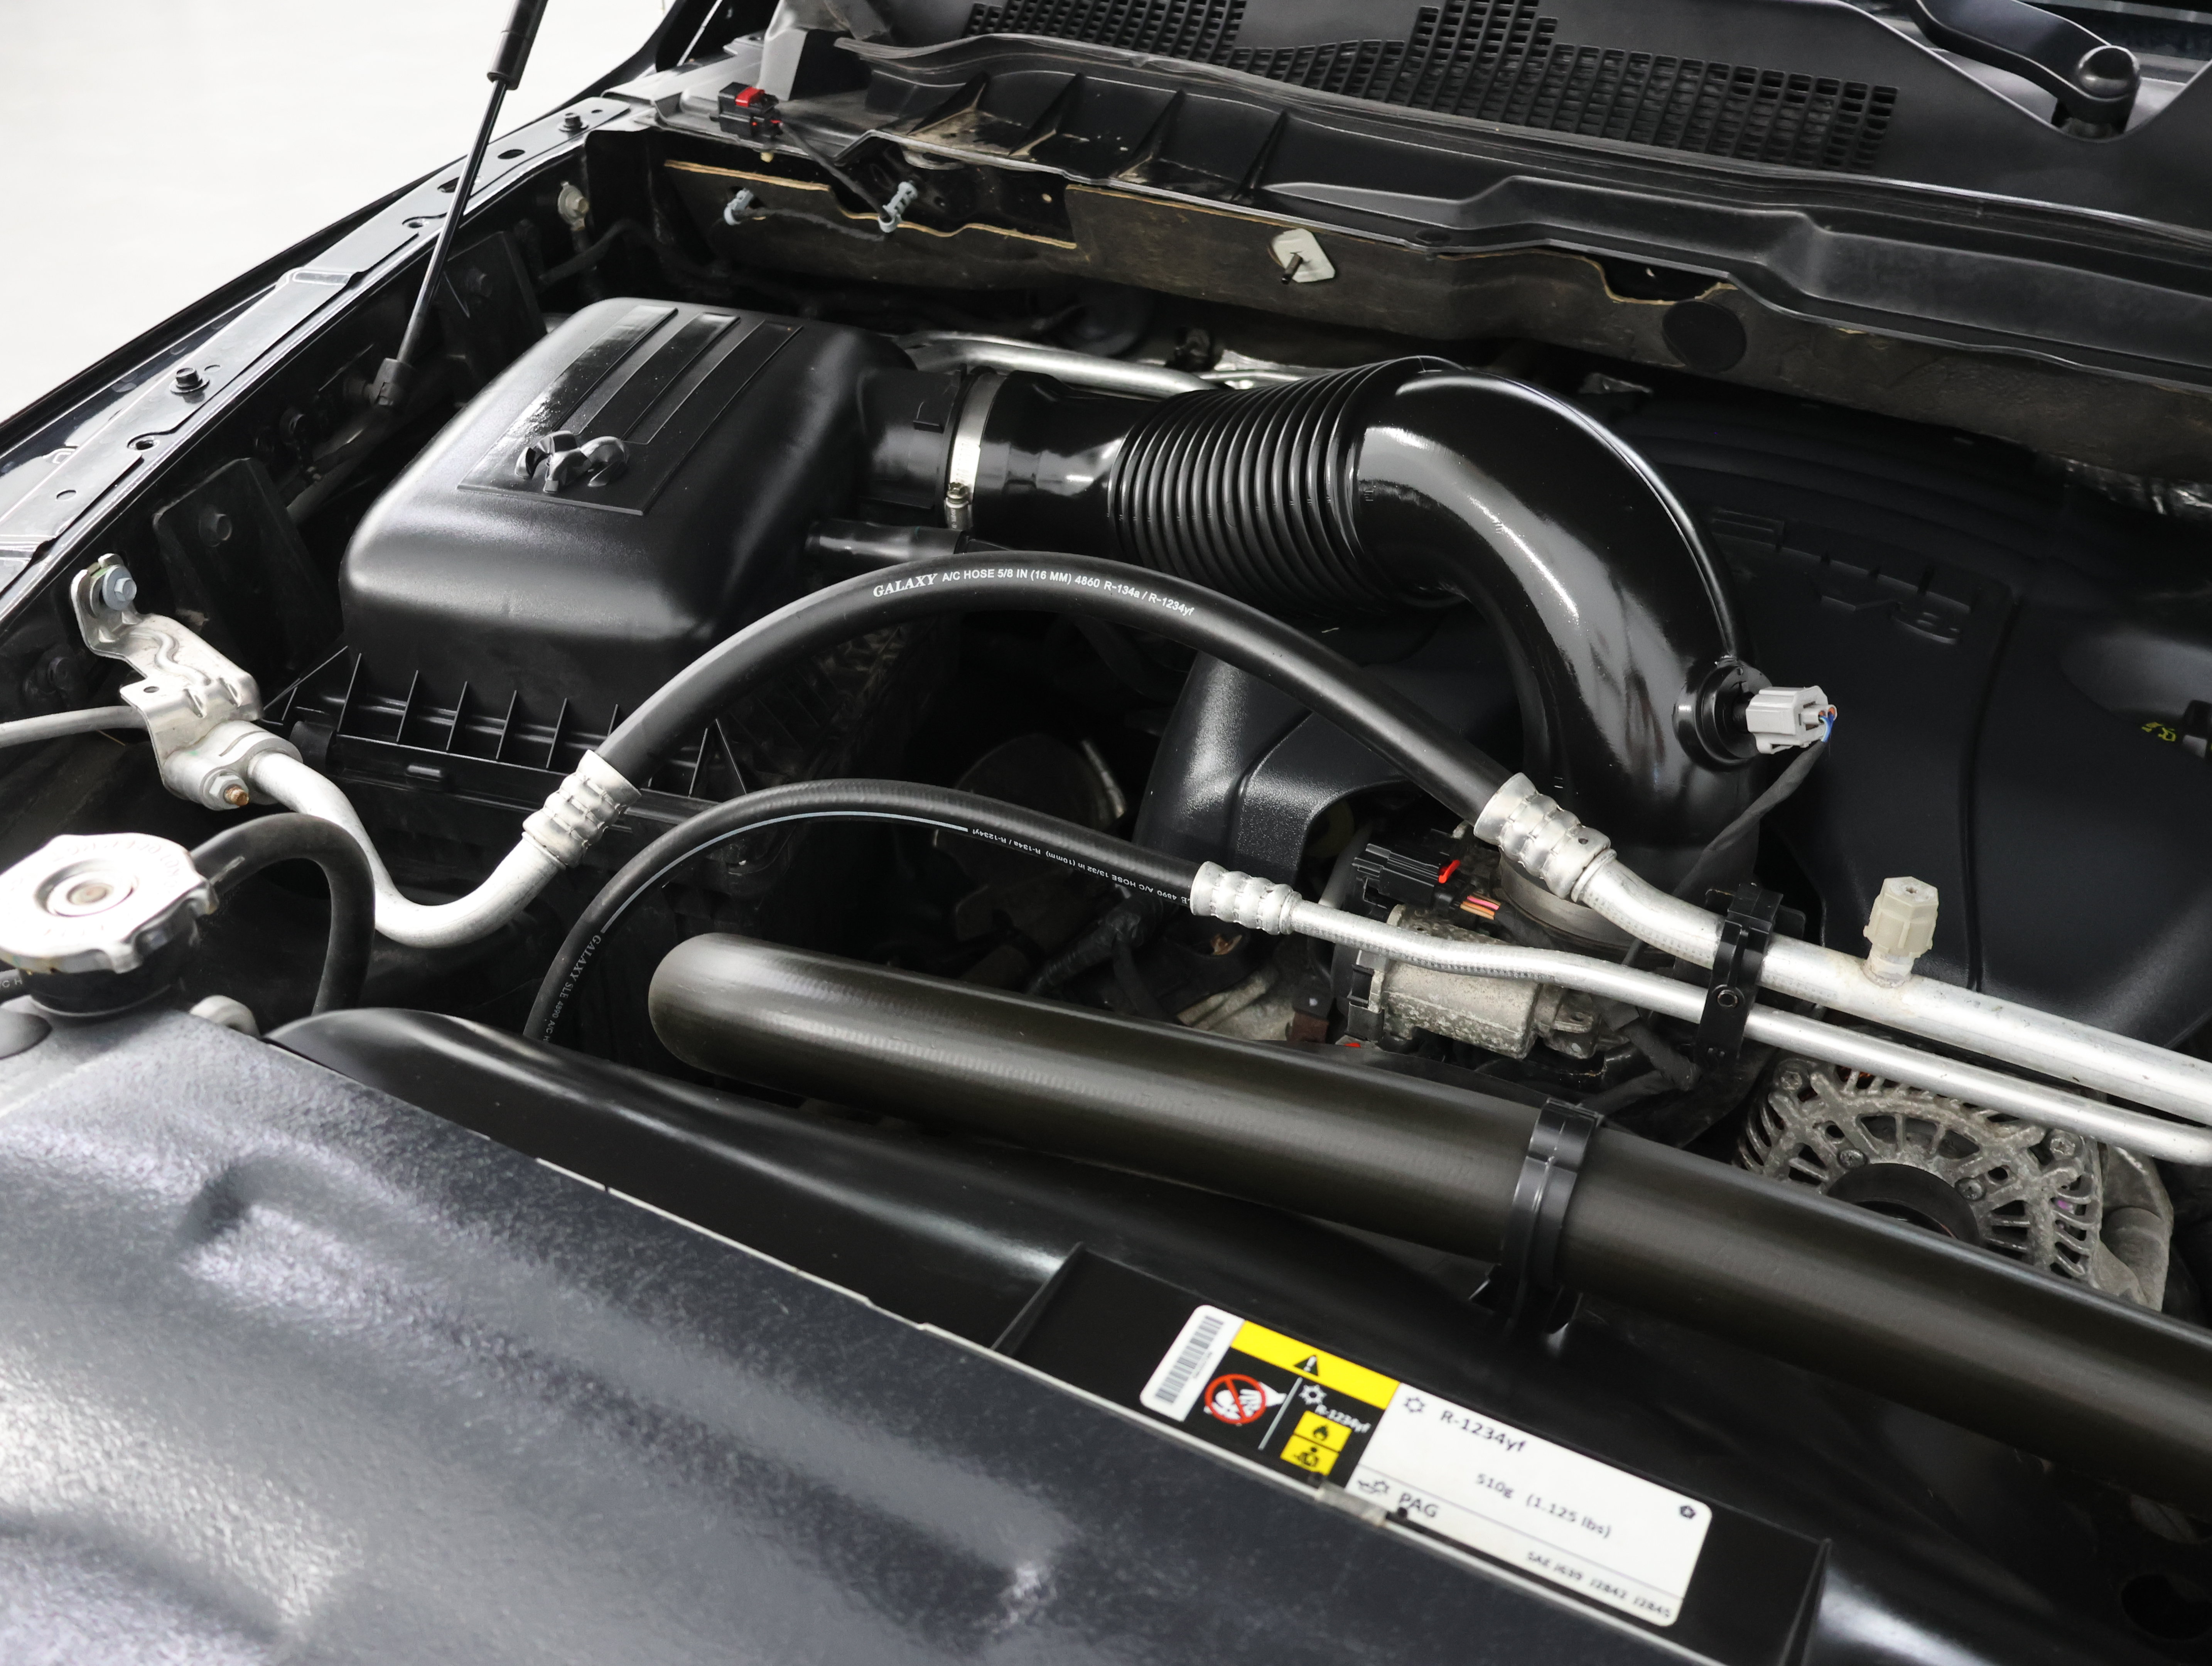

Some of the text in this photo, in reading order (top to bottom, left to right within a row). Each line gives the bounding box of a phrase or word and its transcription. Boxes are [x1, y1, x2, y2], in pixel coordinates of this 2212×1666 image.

[873, 568, 1195, 616] GALAXY A/C HOSE 5/8 IN (16 MM) 4860 R-134a / R-1234yf
[972, 828, 1006, 843] R-1234yf
[1014, 840, 1041, 855] R-134a
[1046, 850, 1075, 867] (10mm)
[1087, 866, 1109, 877] 13/32
[1111, 875, 1136, 887] HOSE
[1139, 884, 1154, 893] A/C
[1156, 890, 1177, 900] 4890
[570, 935, 601, 982] GALAXY
[559, 982, 574, 998] SLE
[1441, 1410, 1527, 1452] R-1234yf
[1399, 1492, 1439, 1518] PAG
[1476, 1473, 1611, 1539] 510g (1.125 lbs)
